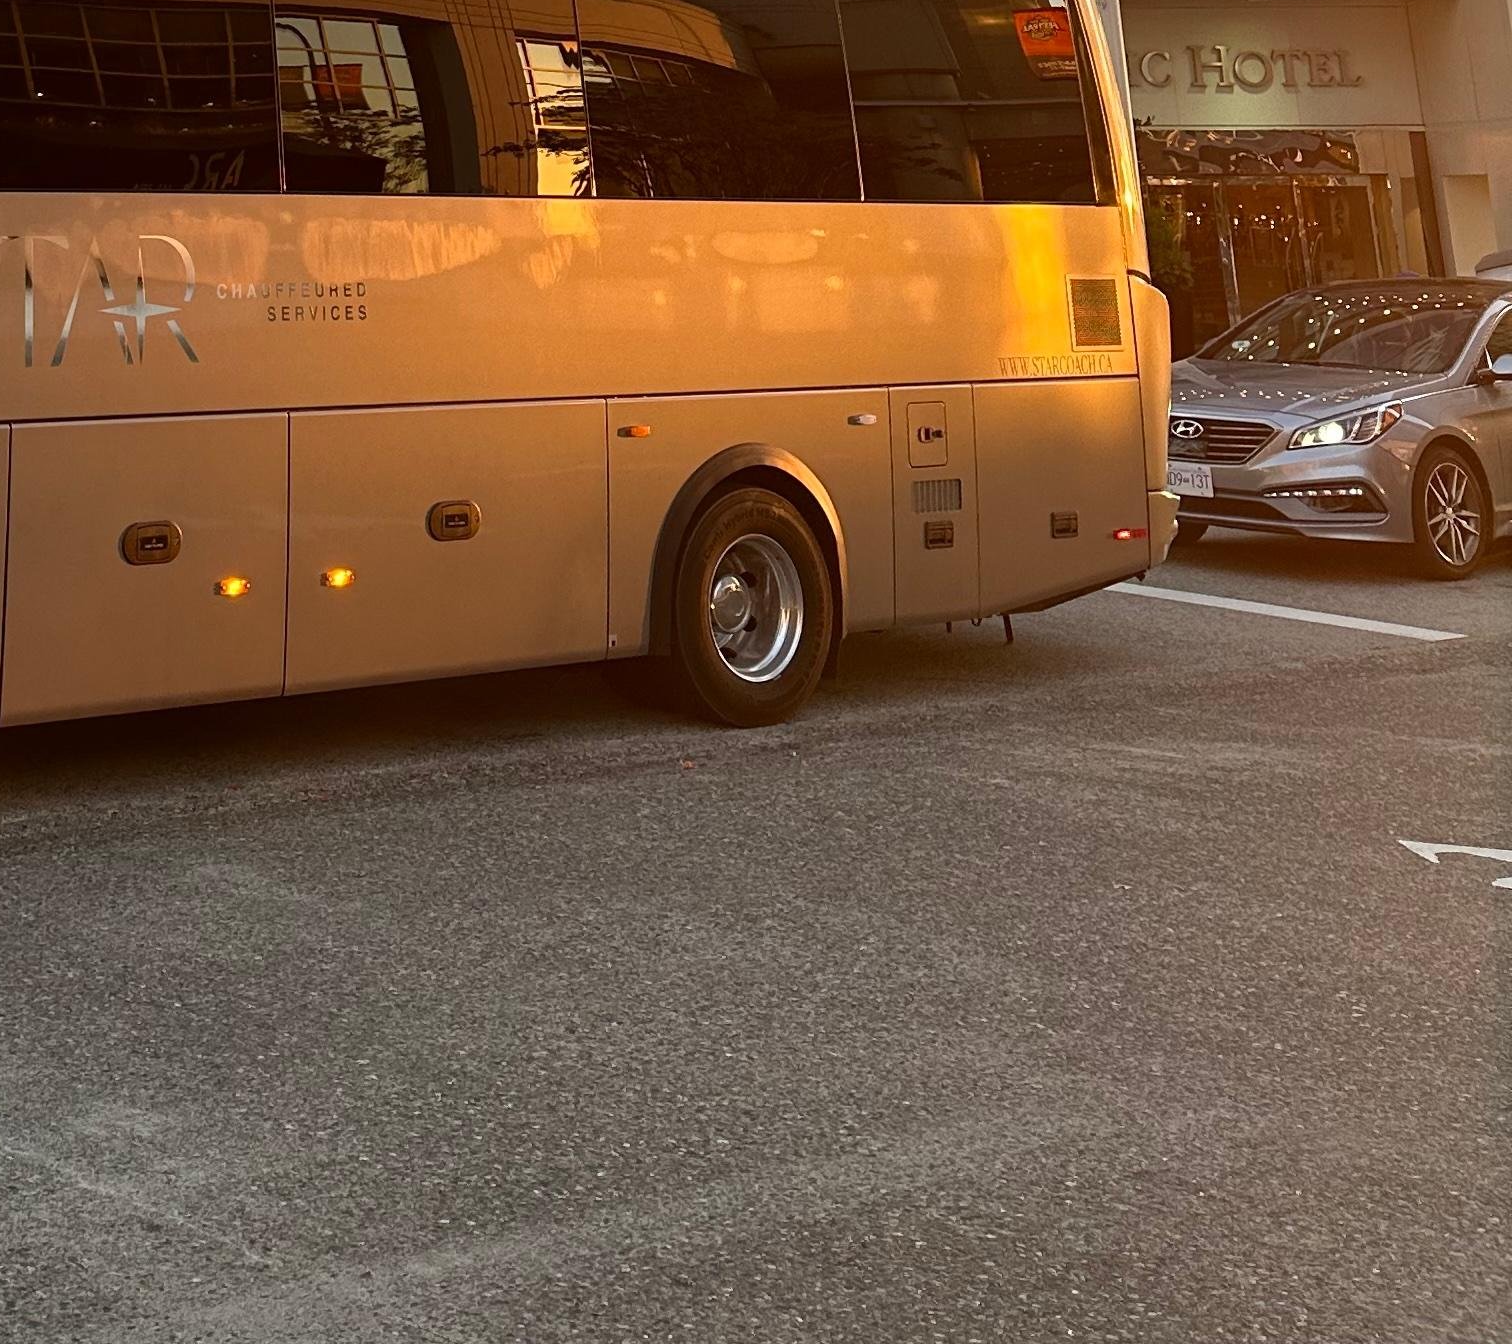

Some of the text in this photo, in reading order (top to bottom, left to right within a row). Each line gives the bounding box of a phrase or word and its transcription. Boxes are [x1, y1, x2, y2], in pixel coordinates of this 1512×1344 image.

[1187, 45, 1362, 89] HOTEL
[215, 282, 367, 300] CHAUFFEURED
[267, 305, 368, 322] SERVICES
[997, 353, 1113, 377] WWW.STARCOACH.CA
